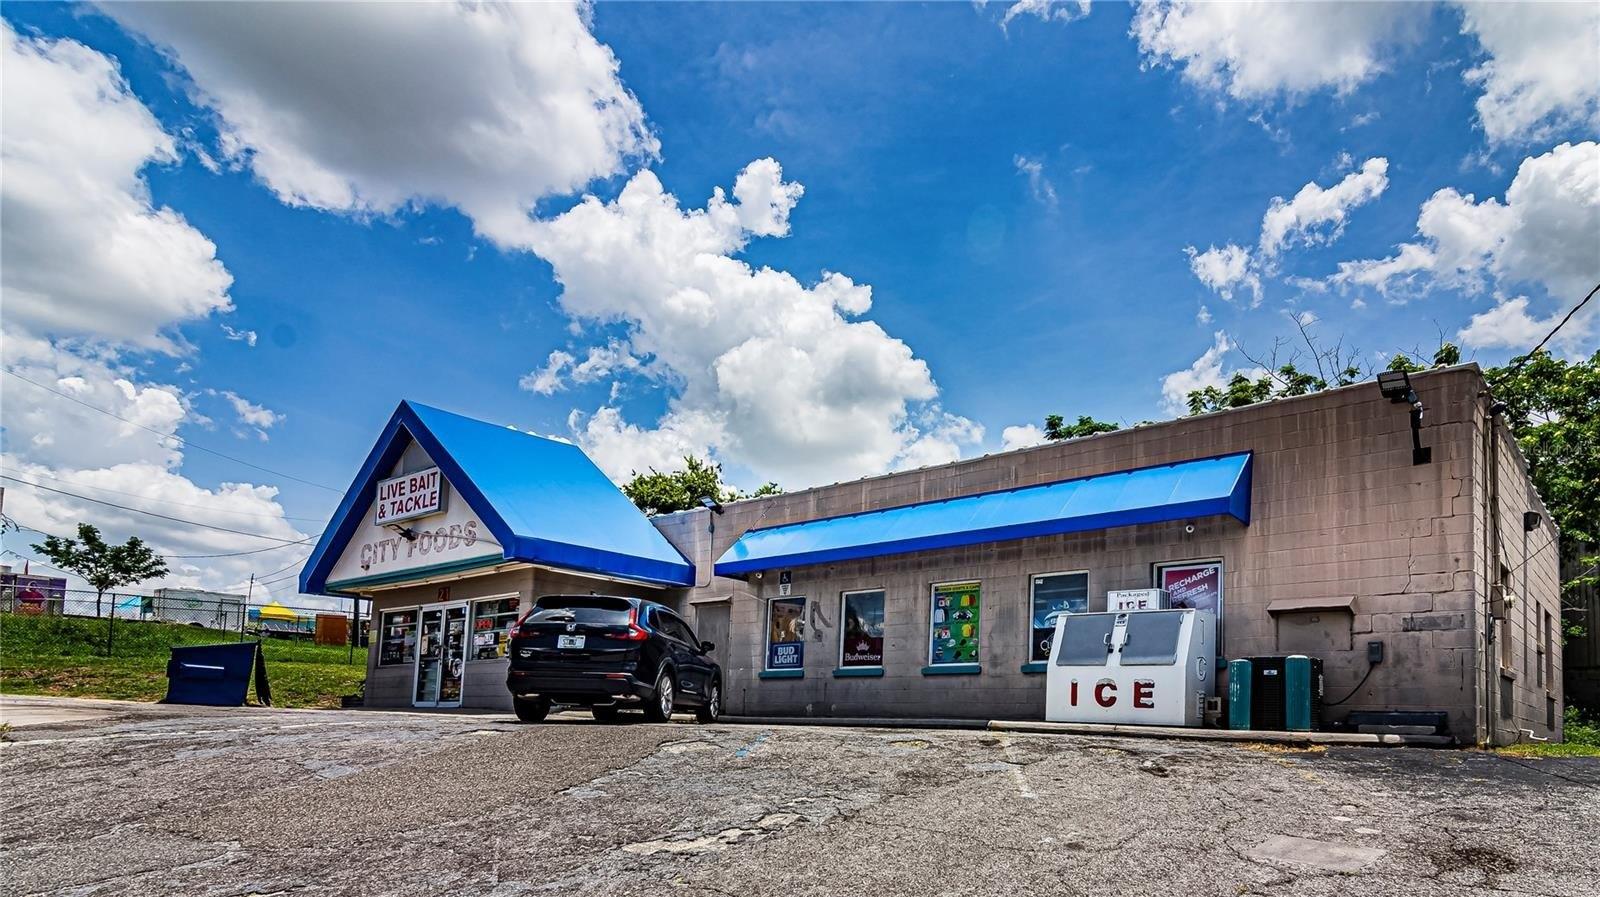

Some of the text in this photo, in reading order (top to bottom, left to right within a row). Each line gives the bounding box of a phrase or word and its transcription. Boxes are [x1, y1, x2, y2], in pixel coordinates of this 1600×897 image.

[380, 471, 438, 501] LIVE BAIT
[378, 491, 438, 519] & TACKLE
[360, 520, 477, 566] CITY FOODS
[1168, 567, 1216, 592] RECHARGE
[439, 588, 449, 601] 21
[1116, 591, 1150, 599] Packaged
[1172, 583, 1209, 603] REFRESH
[1173, 586, 1187, 597] AND
[1118, 600, 1148, 610] ICE
[777, 646, 795, 656] BUD
[844, 652, 881, 662] Budweiser
[774, 654, 799, 664] LIGHT
[1070, 678, 1156, 709] ICE
